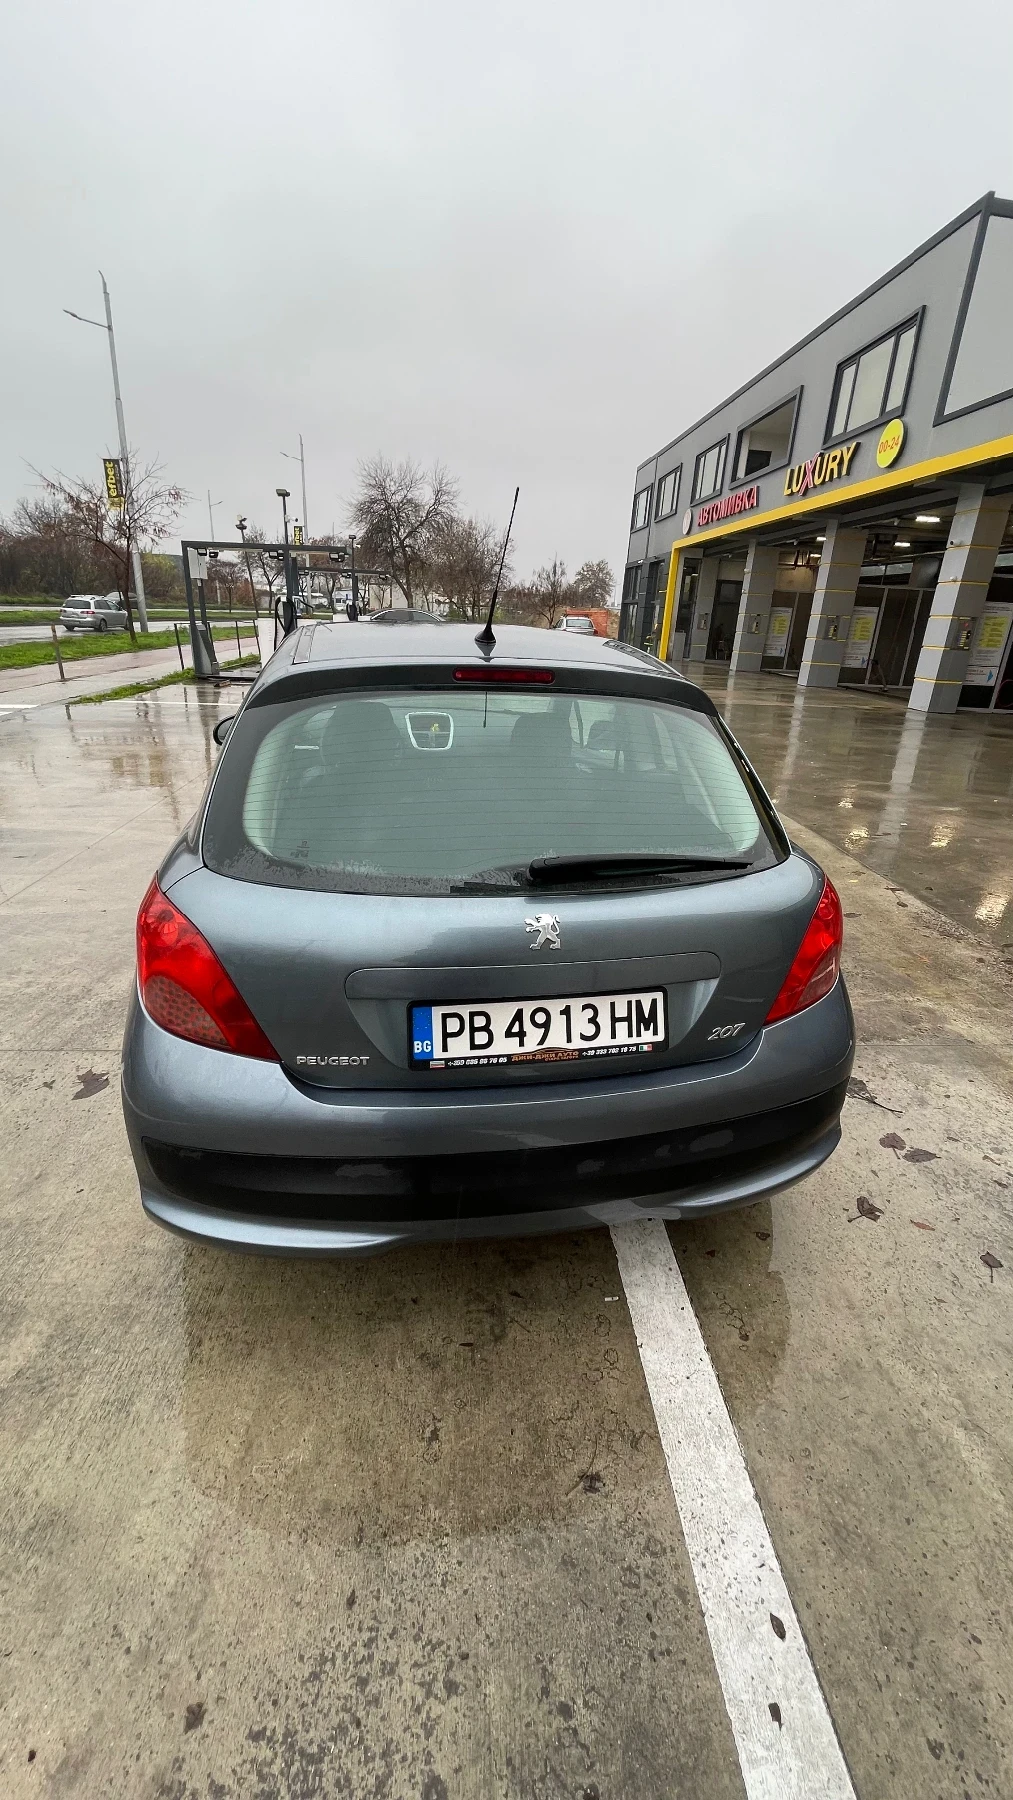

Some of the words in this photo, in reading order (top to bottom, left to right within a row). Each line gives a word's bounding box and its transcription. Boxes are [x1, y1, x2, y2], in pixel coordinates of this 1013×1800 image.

[878, 435, 901, 454] 00-24
[105, 461, 118, 497] efbet
[784, 441, 858, 496] LUXURY
[697, 485, 758, 526] АВТОМИВКА
[441, 1010, 494, 1053] PB
[504, 1003, 601, 1047] 4913
[610, 997, 659, 1040] HM
[707, 1022, 746, 1041] 207
[413, 1040, 432, 1053] BG
[296, 1055, 370, 1066] PEUGEOT
